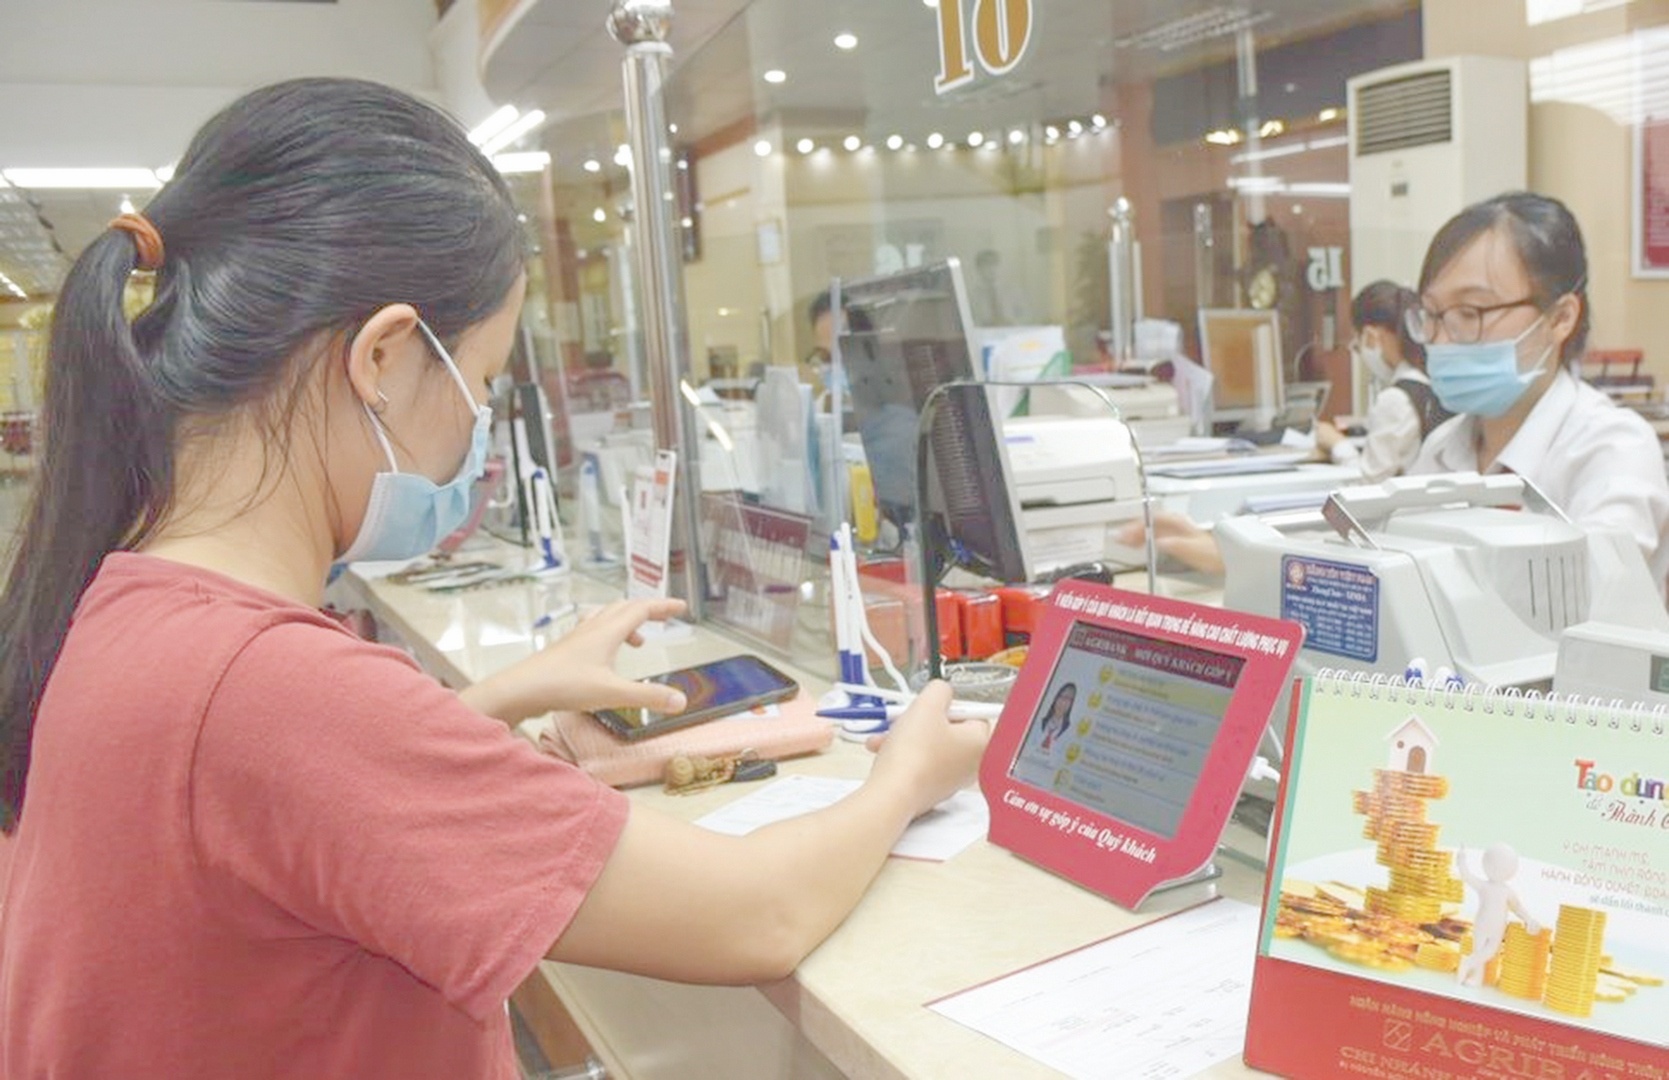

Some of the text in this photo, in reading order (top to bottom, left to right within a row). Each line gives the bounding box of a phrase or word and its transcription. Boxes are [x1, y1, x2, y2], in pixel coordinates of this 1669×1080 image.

[934, 0, 1033, 95] 10
[1071, 594, 1085, 611] GÓP
[1085, 595, 1100, 615] CỦA
[1107, 602, 1129, 621] KHÁCH
[1145, 611, 1164, 629] QUAN
[1205, 624, 1222, 641] CAO
[1574, 759, 1614, 797] Tạo
[1601, 799, 1657, 828] Thành
[1049, 811, 1072, 831] góp
[1067, 816, 1081, 834] ý
[1096, 828, 1124, 852] Quý
[1119, 837, 1157, 865] khách
[1339, 1046, 1377, 1065] CHI
